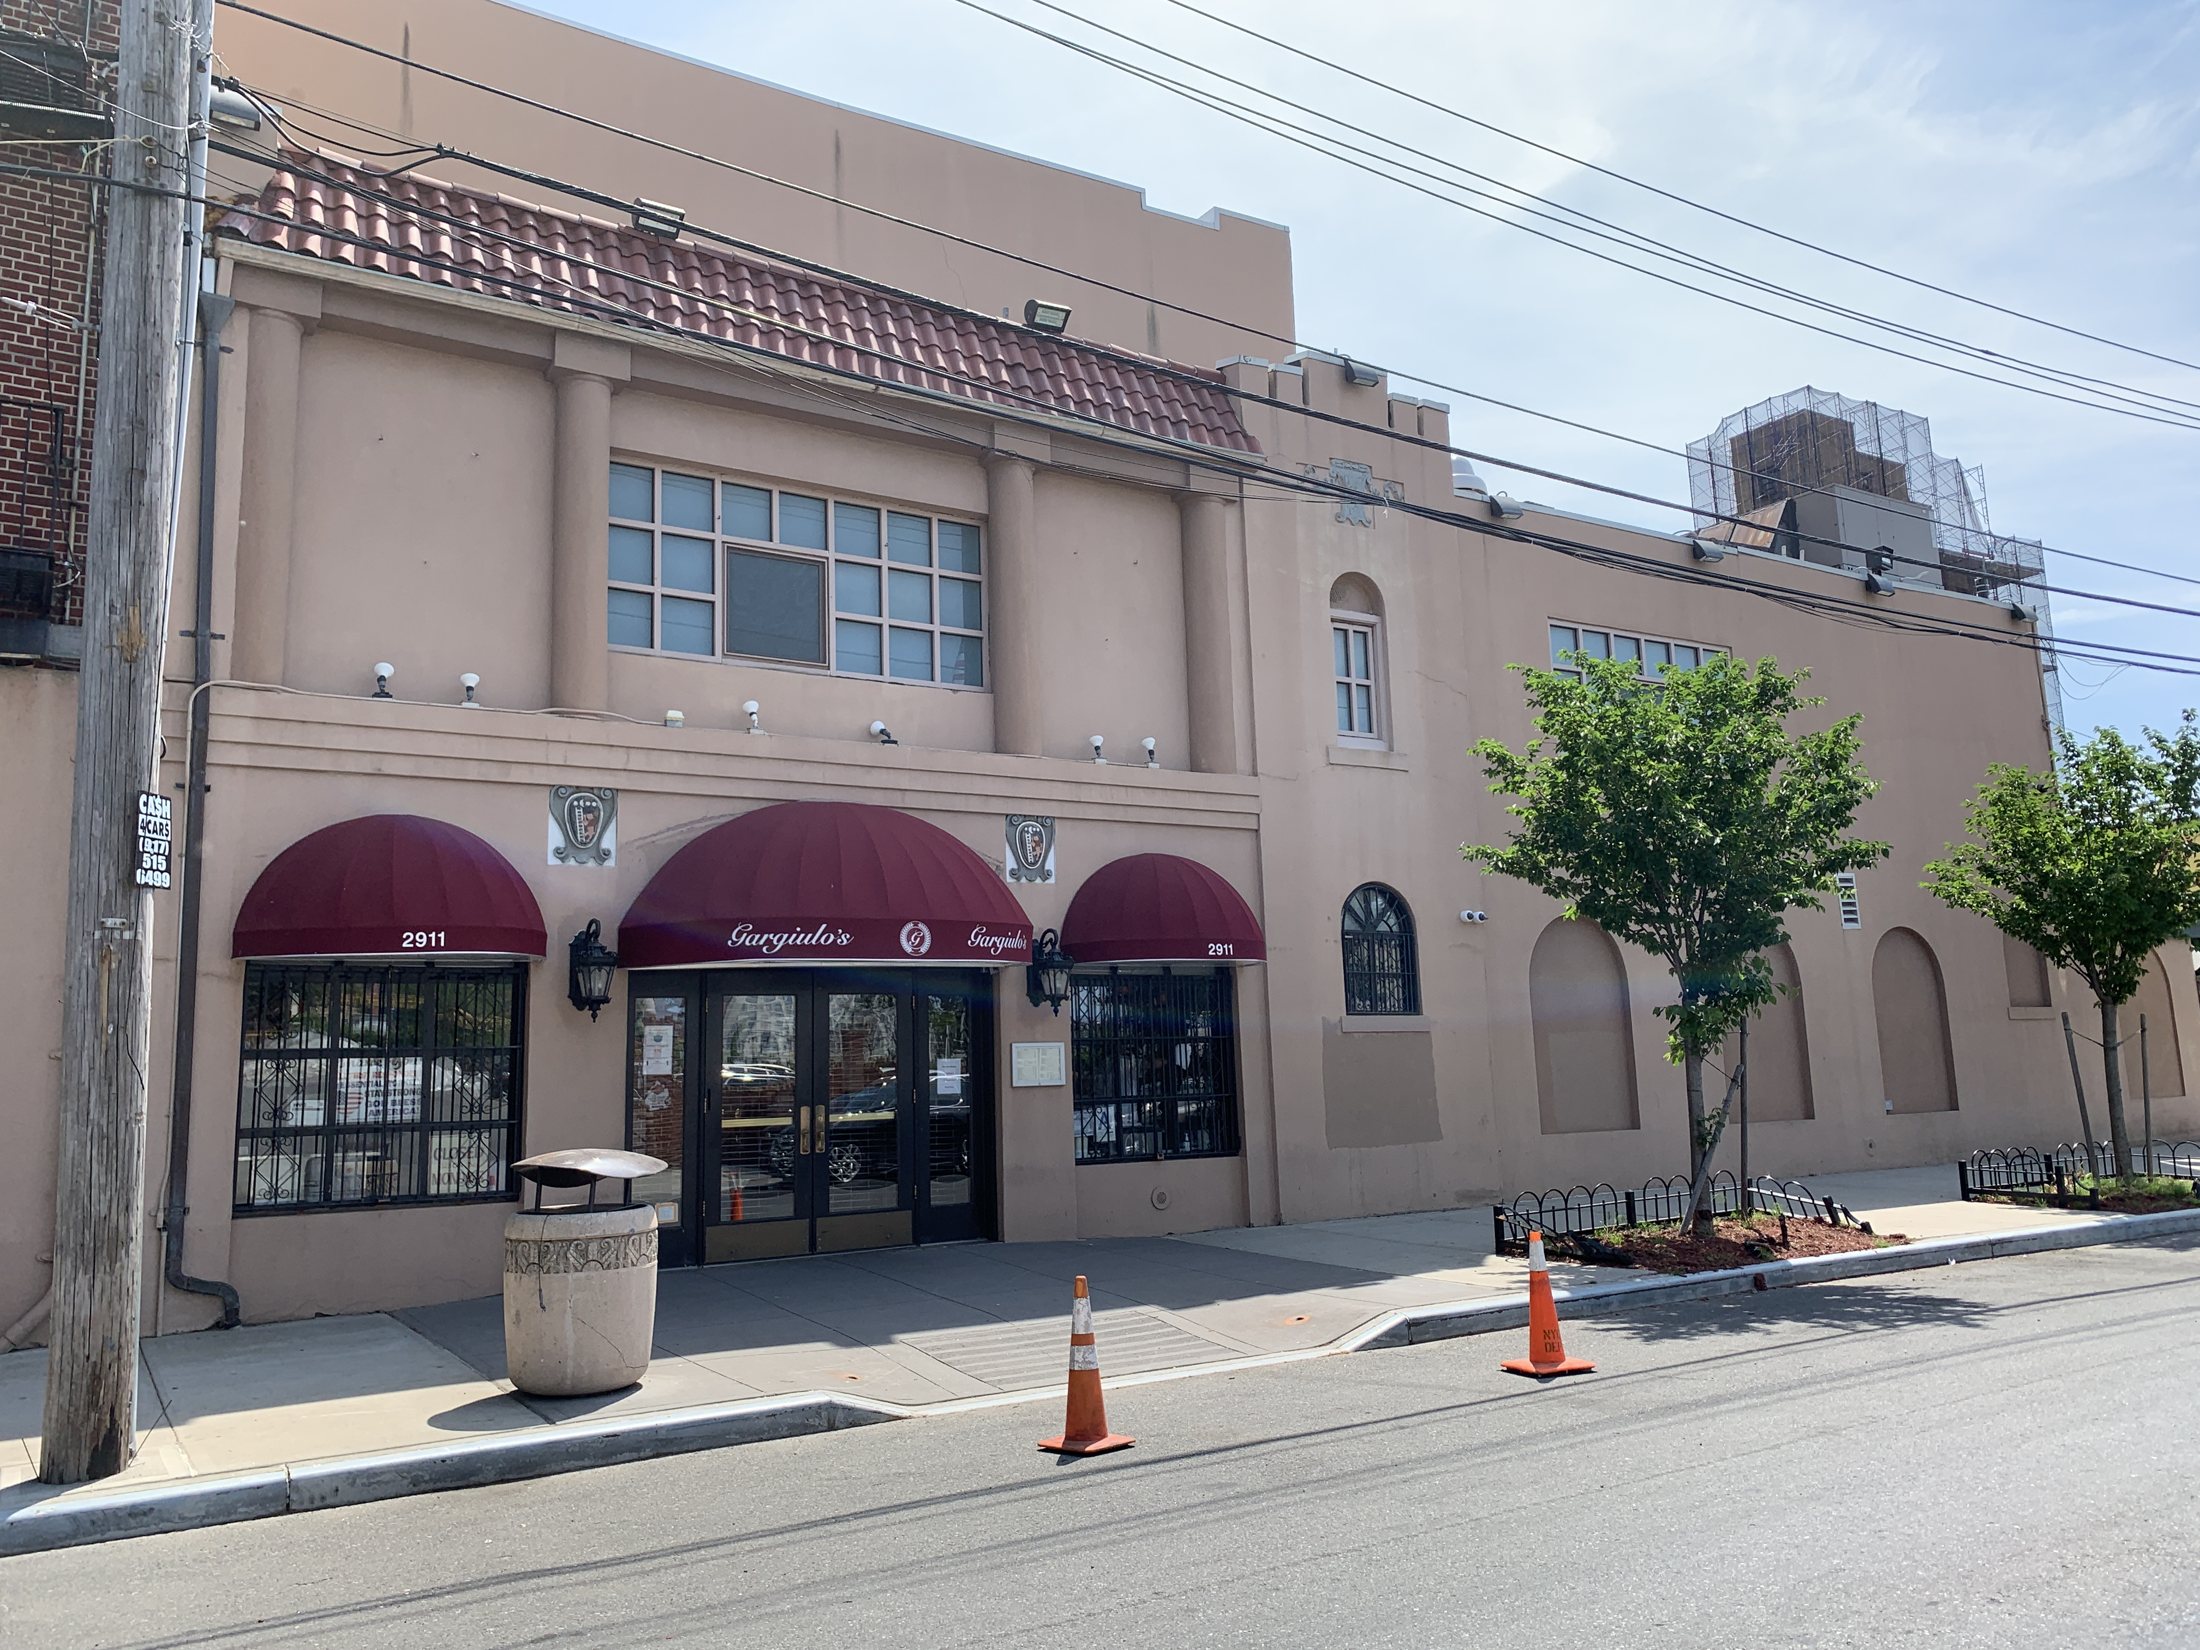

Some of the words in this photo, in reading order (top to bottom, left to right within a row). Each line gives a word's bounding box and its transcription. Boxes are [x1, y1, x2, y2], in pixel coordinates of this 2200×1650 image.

[139, 837, 169, 856] (917)
[142, 853, 167, 871] 515
[136, 868, 171, 888] 6499
[402, 931, 445, 948] 2911
[728, 922, 854, 954] Gargiulo's
[968, 924, 1027, 956] Gargiulo's
[1208, 943, 1233, 956] 2911
[368, 1107, 420, 1117] AMERCA!
